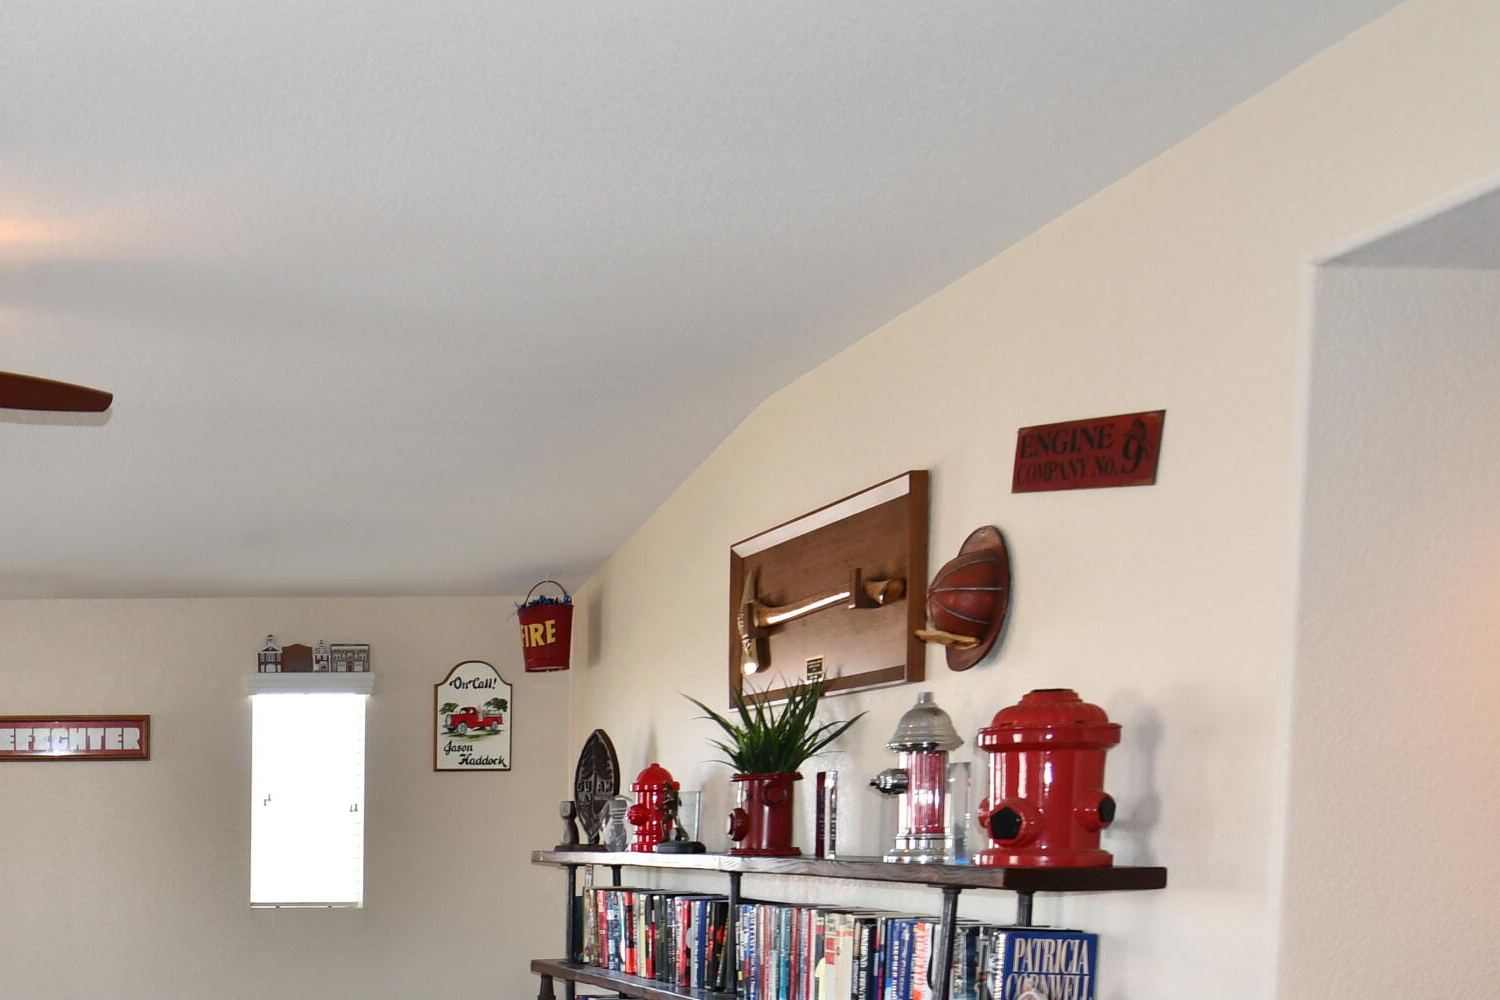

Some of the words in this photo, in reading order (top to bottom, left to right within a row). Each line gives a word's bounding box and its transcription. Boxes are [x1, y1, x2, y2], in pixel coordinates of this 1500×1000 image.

[1021, 423, 1115, 459] ENGINE
[1018, 458, 1086, 483] COMPANY
[468, 677, 497, 691] Call!
[443, 741, 473, 756] Jason
[458, 753, 507, 768] Haddock
[576, 779, 614, 793] GUAM
[1012, 938, 1090, 974] PATRICIA
